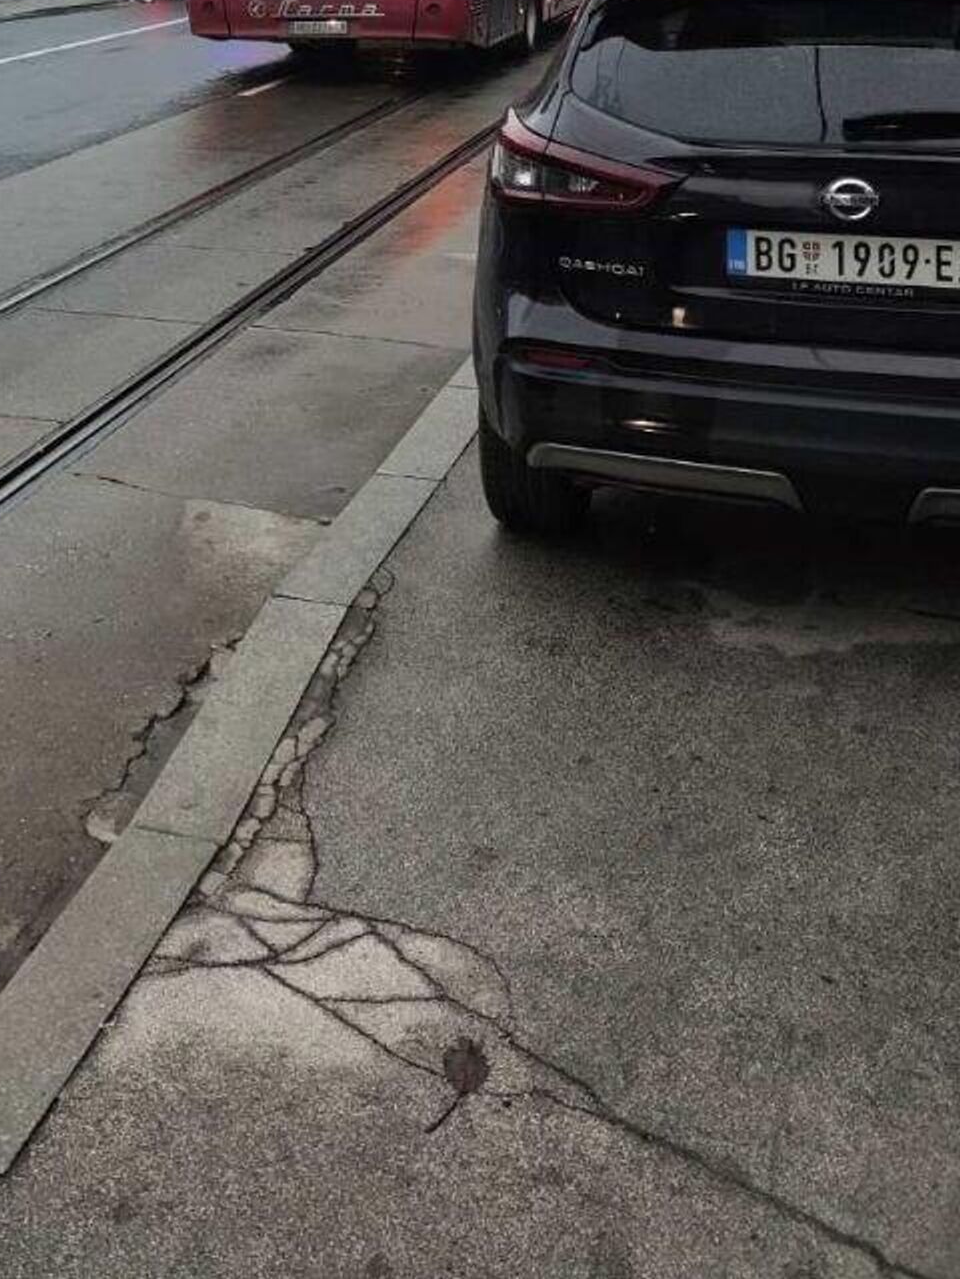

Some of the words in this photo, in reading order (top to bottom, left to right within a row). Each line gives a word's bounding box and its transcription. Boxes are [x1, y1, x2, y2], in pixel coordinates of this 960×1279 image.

[754, 236, 797, 273] BG
[813, 282, 852, 294] AUTO
[855, 284, 914, 298] CENTAR
